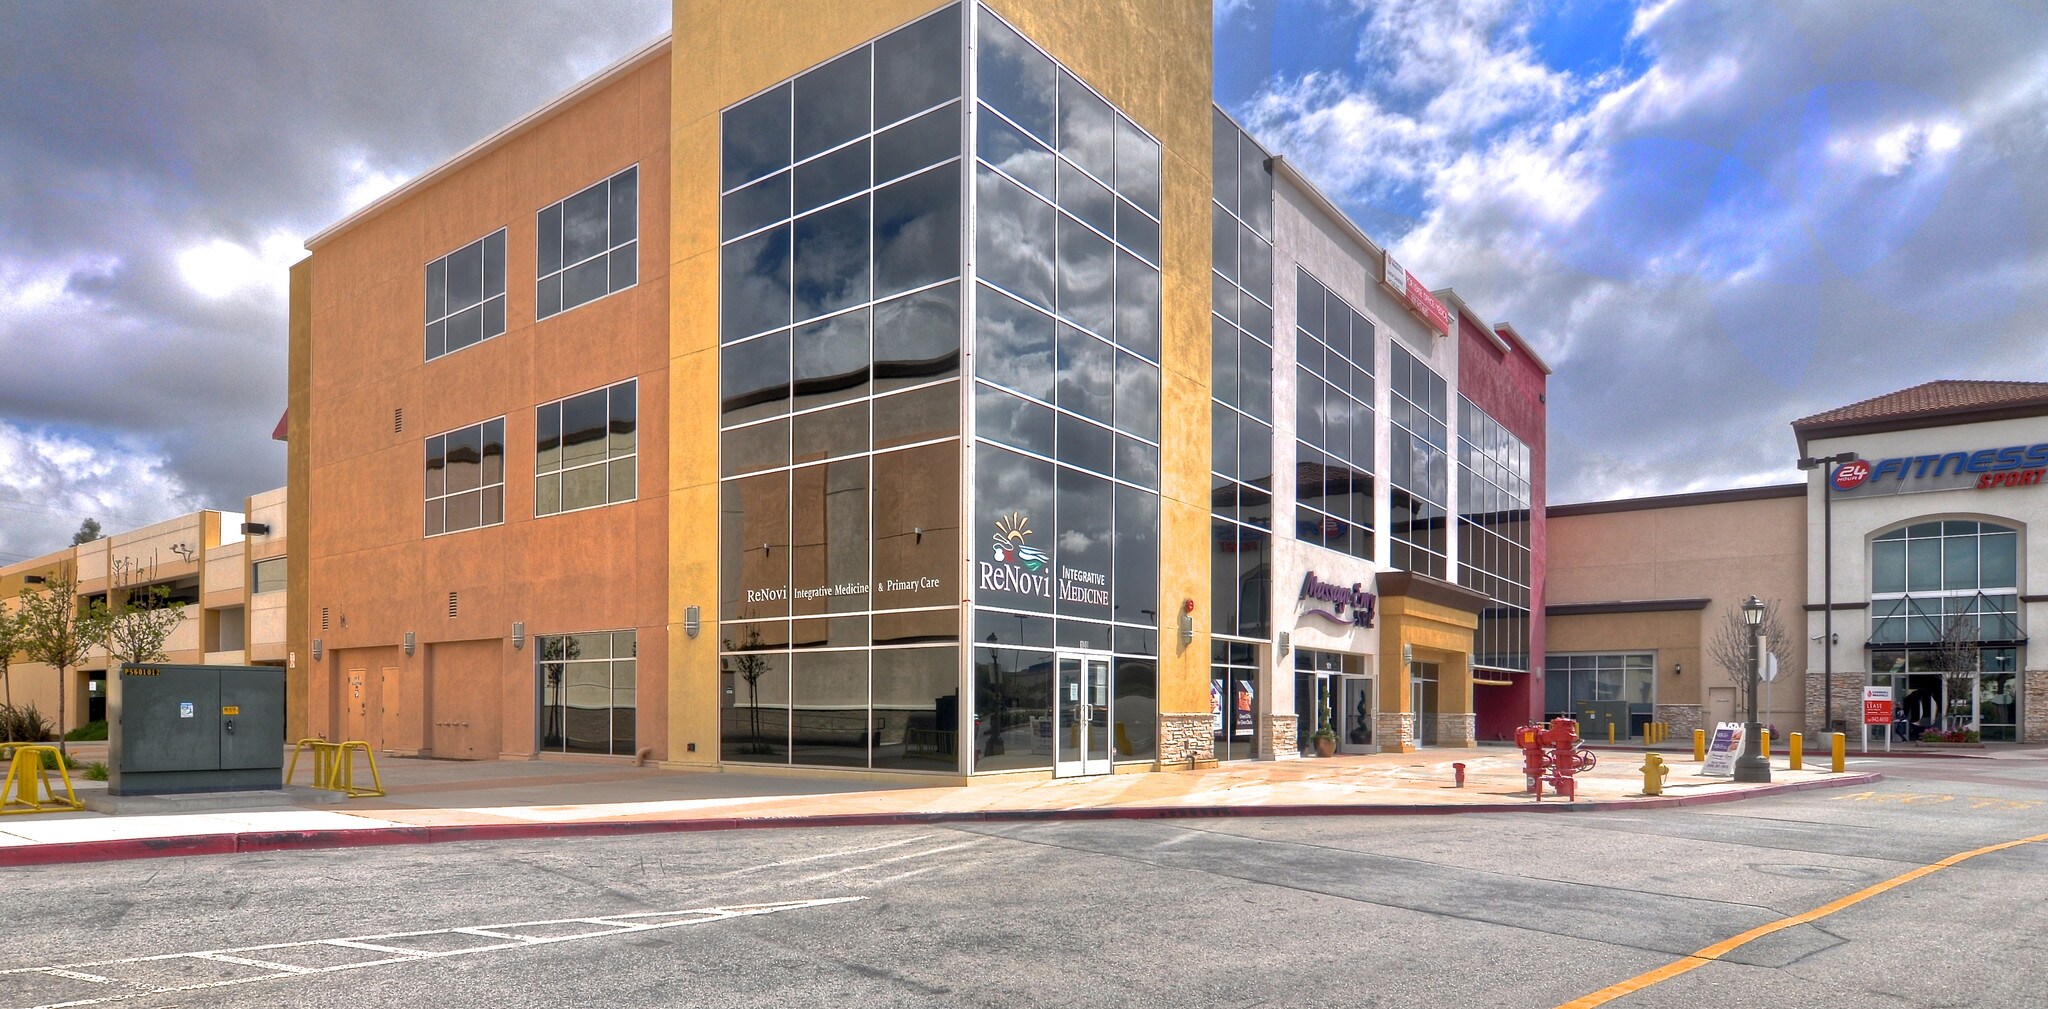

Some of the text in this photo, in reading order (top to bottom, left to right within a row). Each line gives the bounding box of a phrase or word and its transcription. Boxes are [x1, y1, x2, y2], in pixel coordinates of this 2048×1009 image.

[1839, 466, 1868, 480] 24
[1870, 443, 2048, 482] FITNESS
[1976, 469, 2047, 490] SPORT
[979, 561, 1051, 598] ReNovi
[1062, 565, 1105, 586] INTEGRATIVE
[747, 577, 940, 603] ReNovi Integrative Medicine & Primary Care
[1059, 579, 1109, 606] MEDICINE
[1299, 571, 1352, 614] Massage
